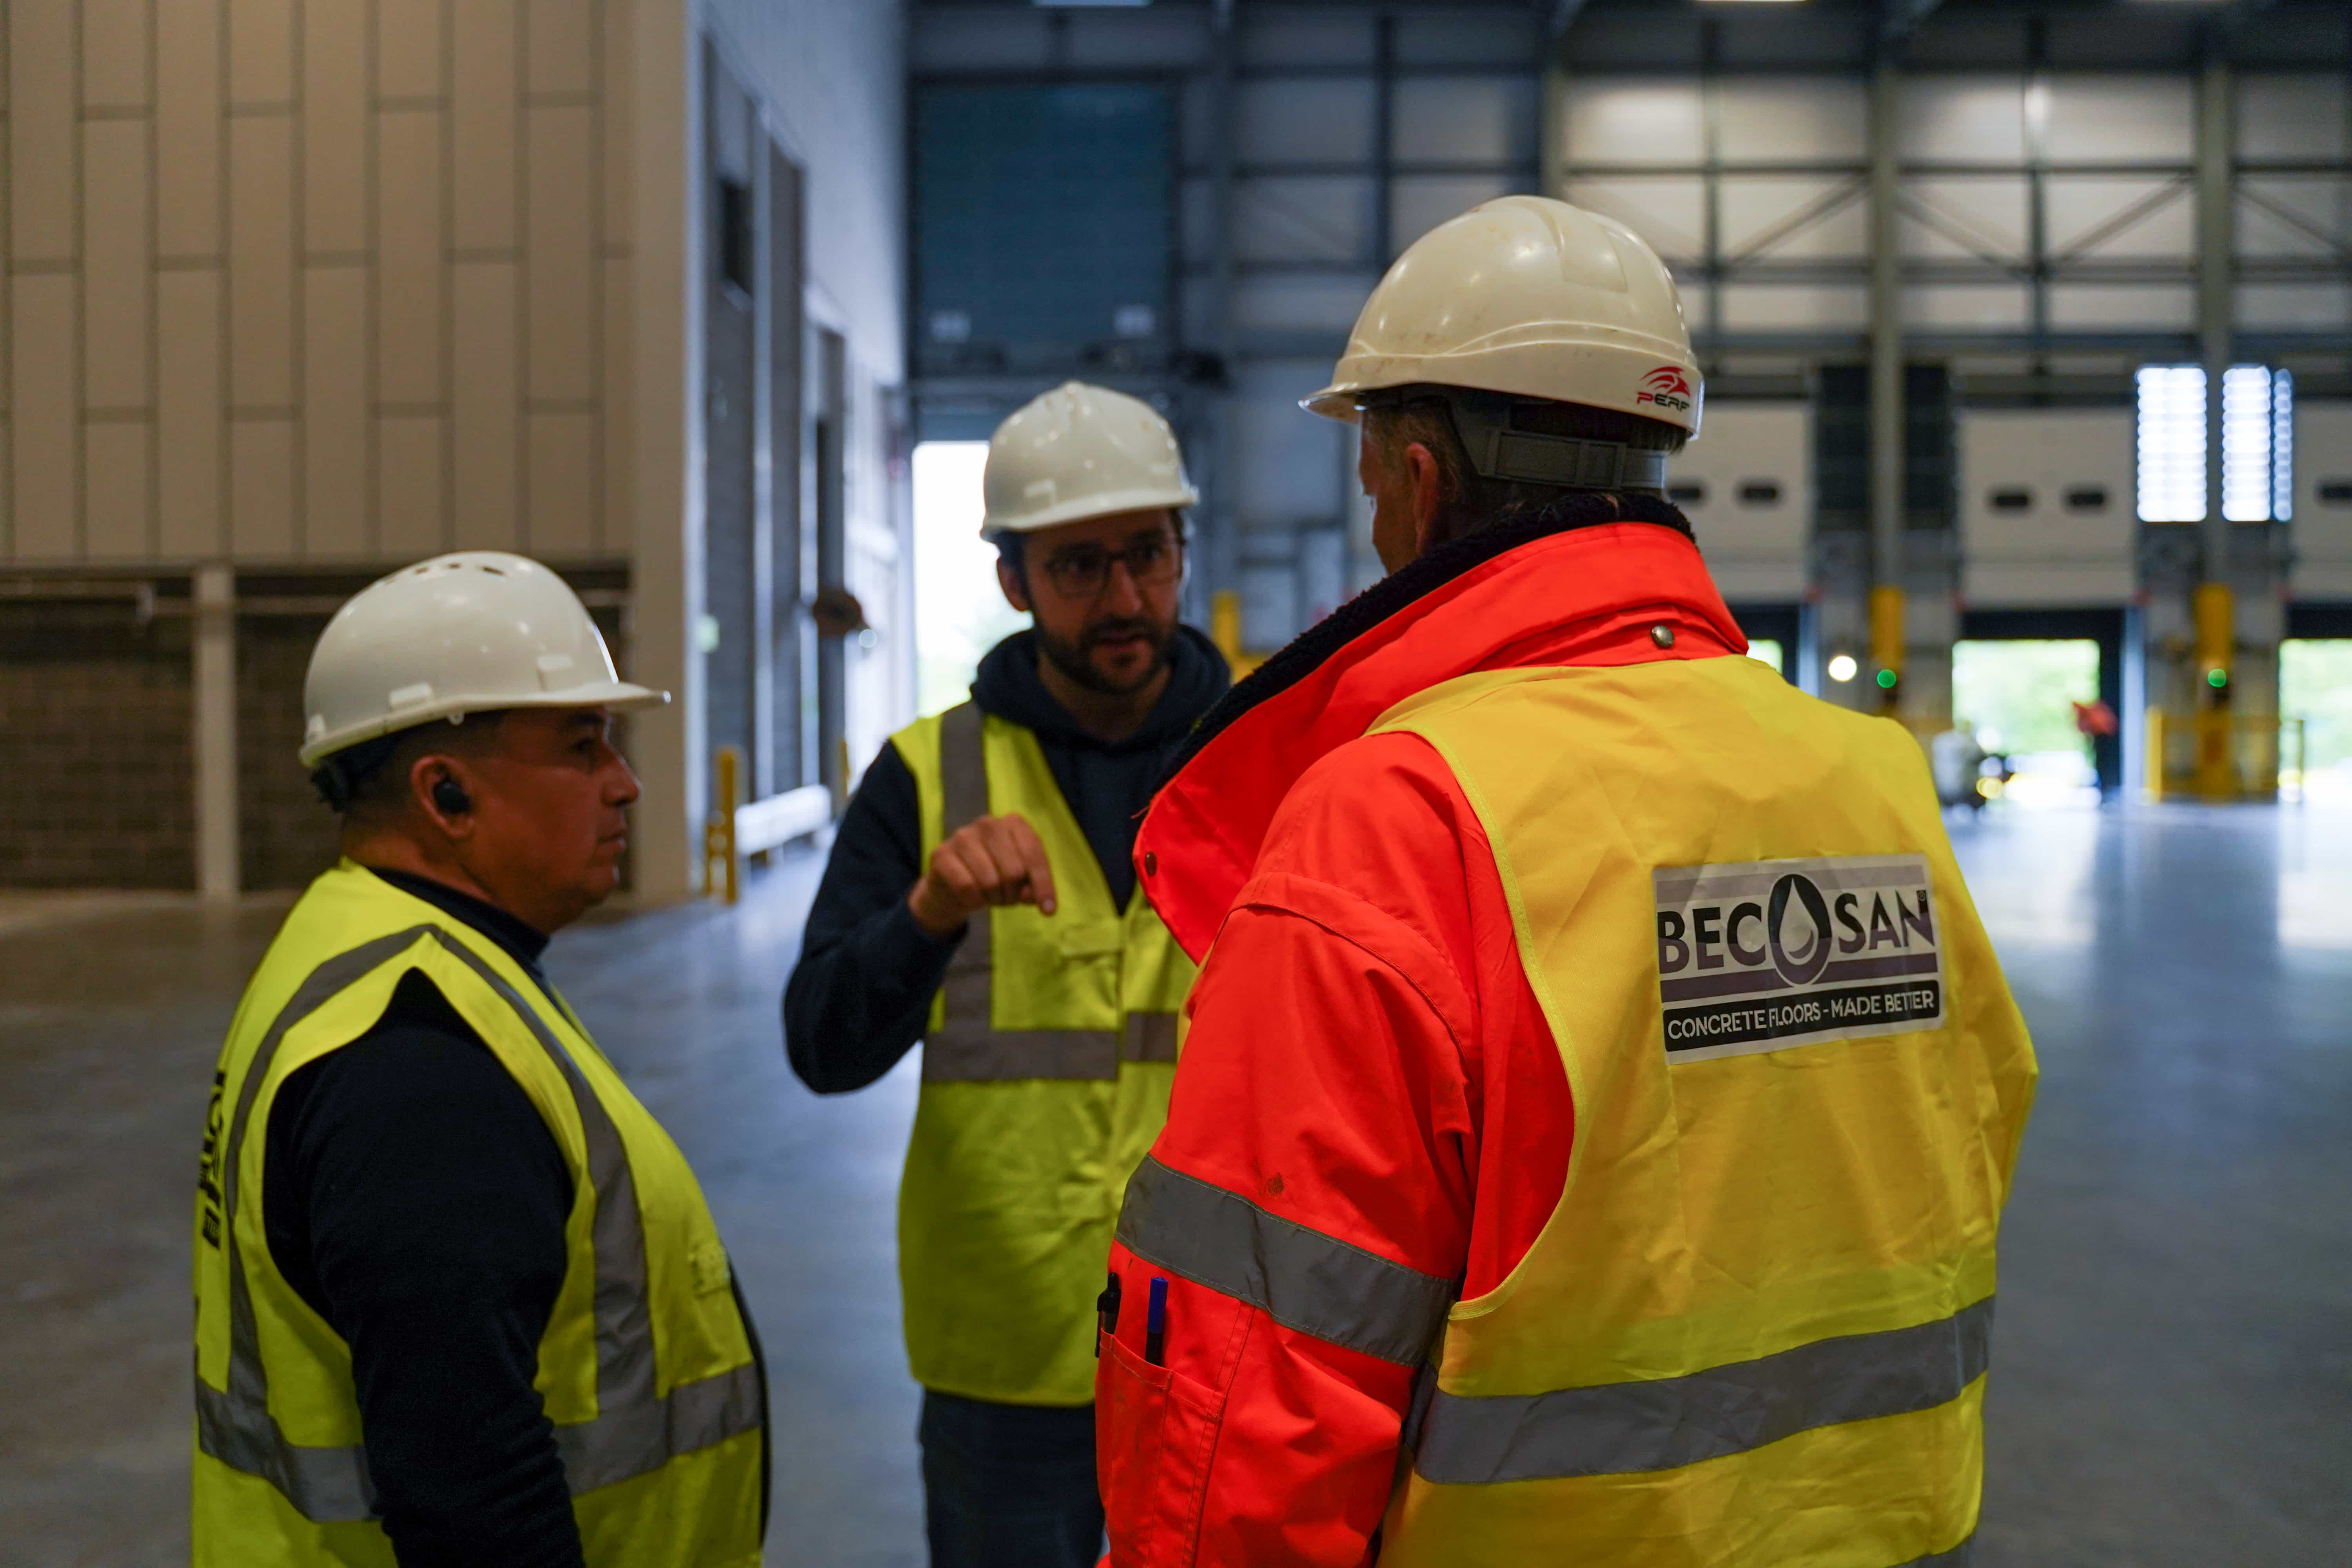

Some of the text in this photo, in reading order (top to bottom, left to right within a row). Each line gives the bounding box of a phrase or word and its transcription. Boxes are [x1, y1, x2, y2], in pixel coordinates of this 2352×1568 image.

[1637, 391, 1690, 412] PERF
[1667, 1009, 1767, 1040] CONCRETE
[1768, 1002, 1821, 1028] FLOORS
[1831, 995, 1882, 1018] MADE
[1885, 990, 1935, 1013] BETTER
